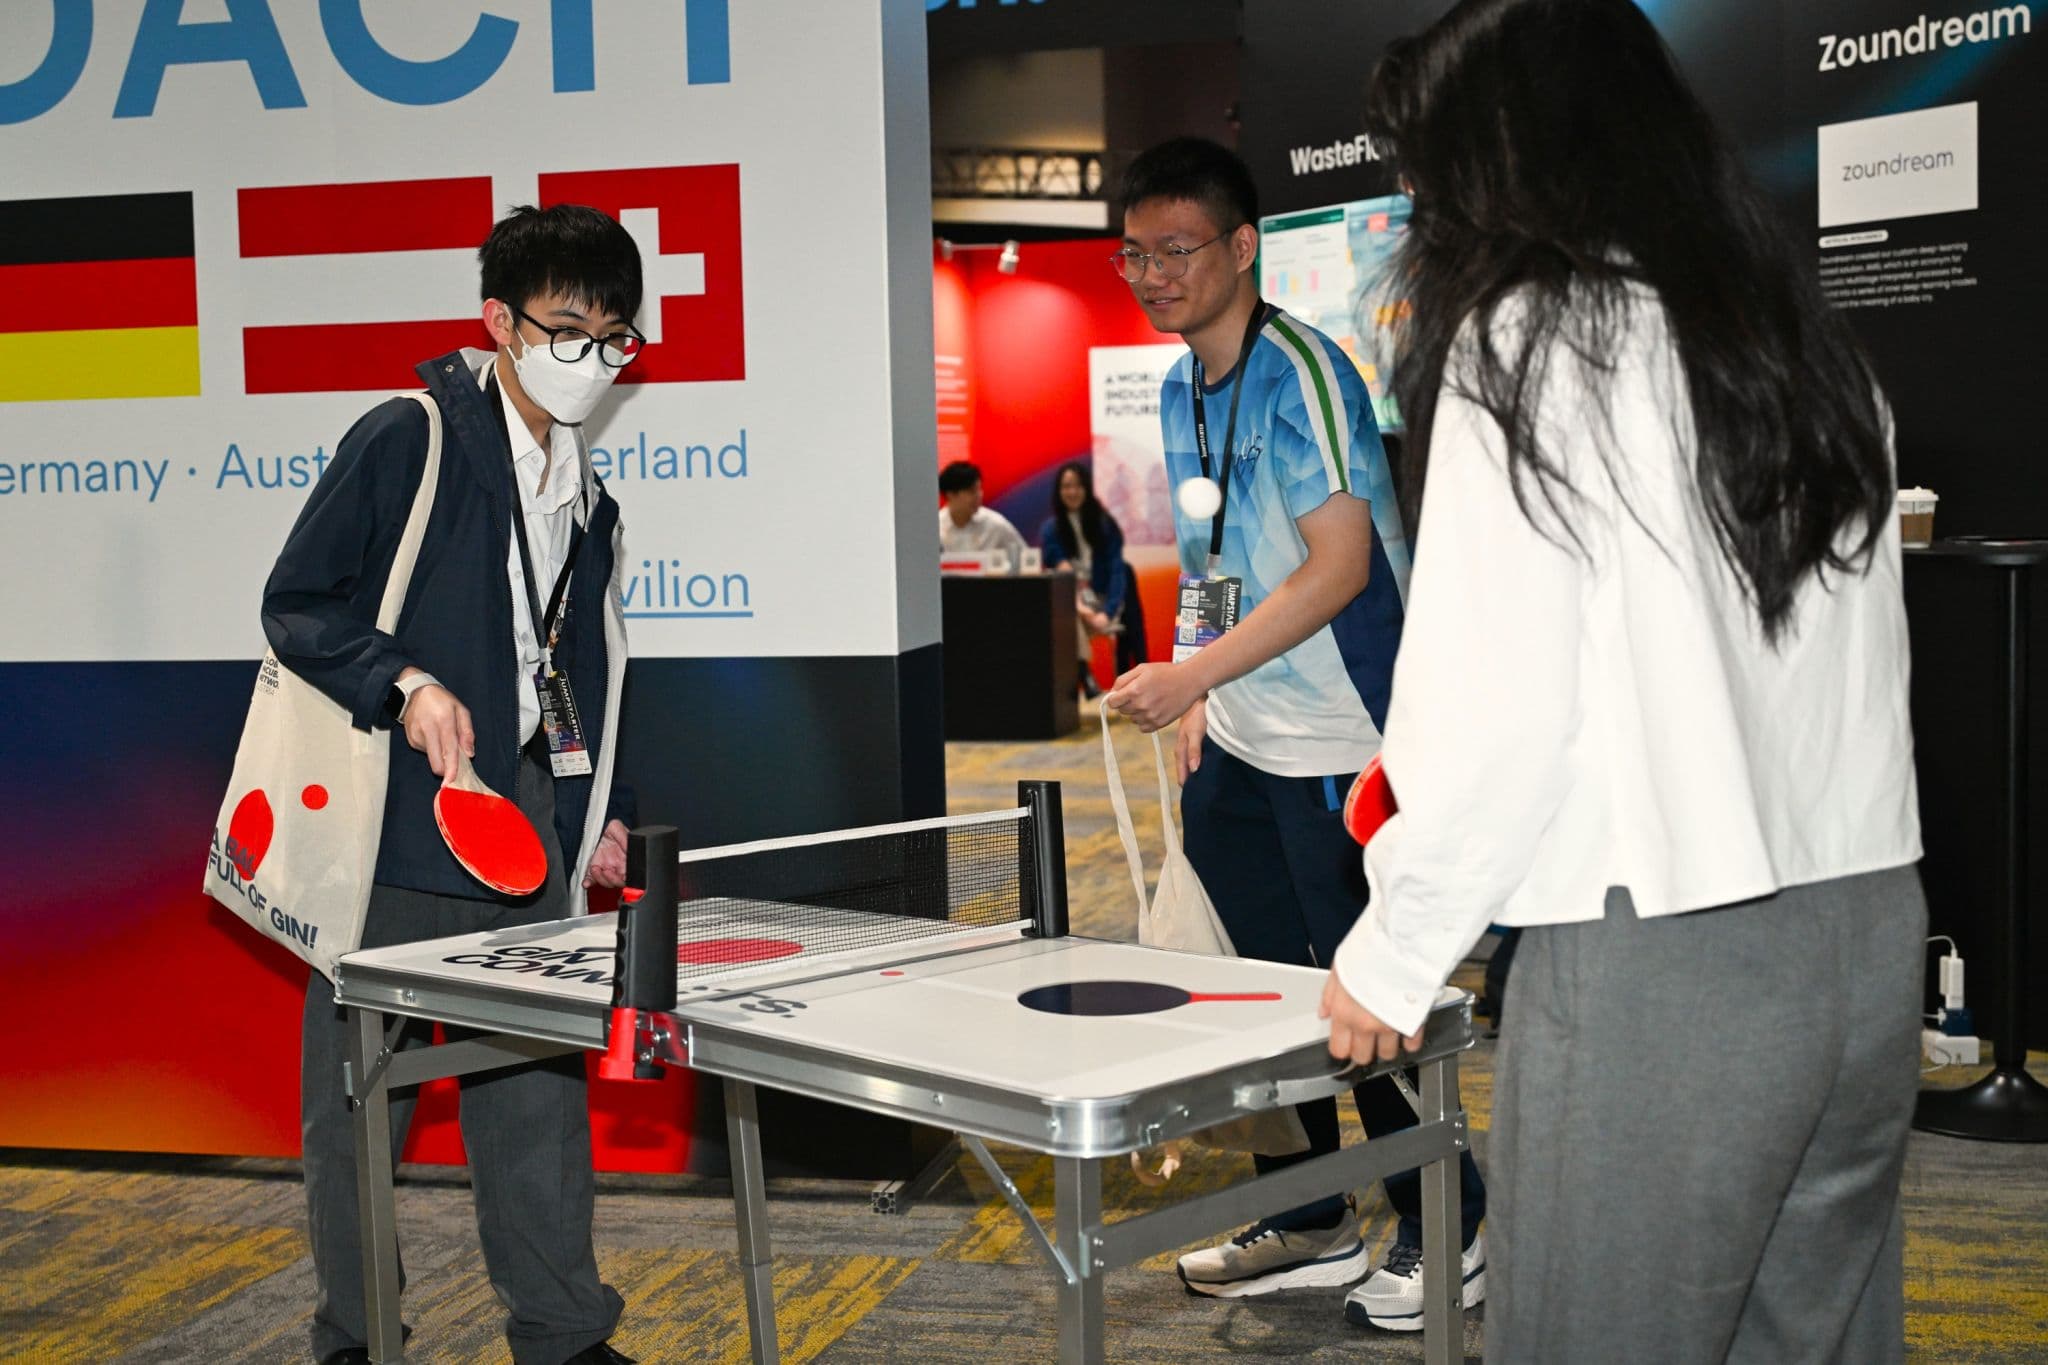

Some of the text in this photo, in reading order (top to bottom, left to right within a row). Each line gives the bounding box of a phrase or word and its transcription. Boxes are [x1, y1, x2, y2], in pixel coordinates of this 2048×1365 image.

[1818, 4, 2031, 72] Zoundream
[1289, 132, 1397, 176] WasteFl
[1842, 150, 1954, 182] zoundream
[209, 851, 318, 950] FULL OF GIN!
[493, 946, 612, 965] GIN
